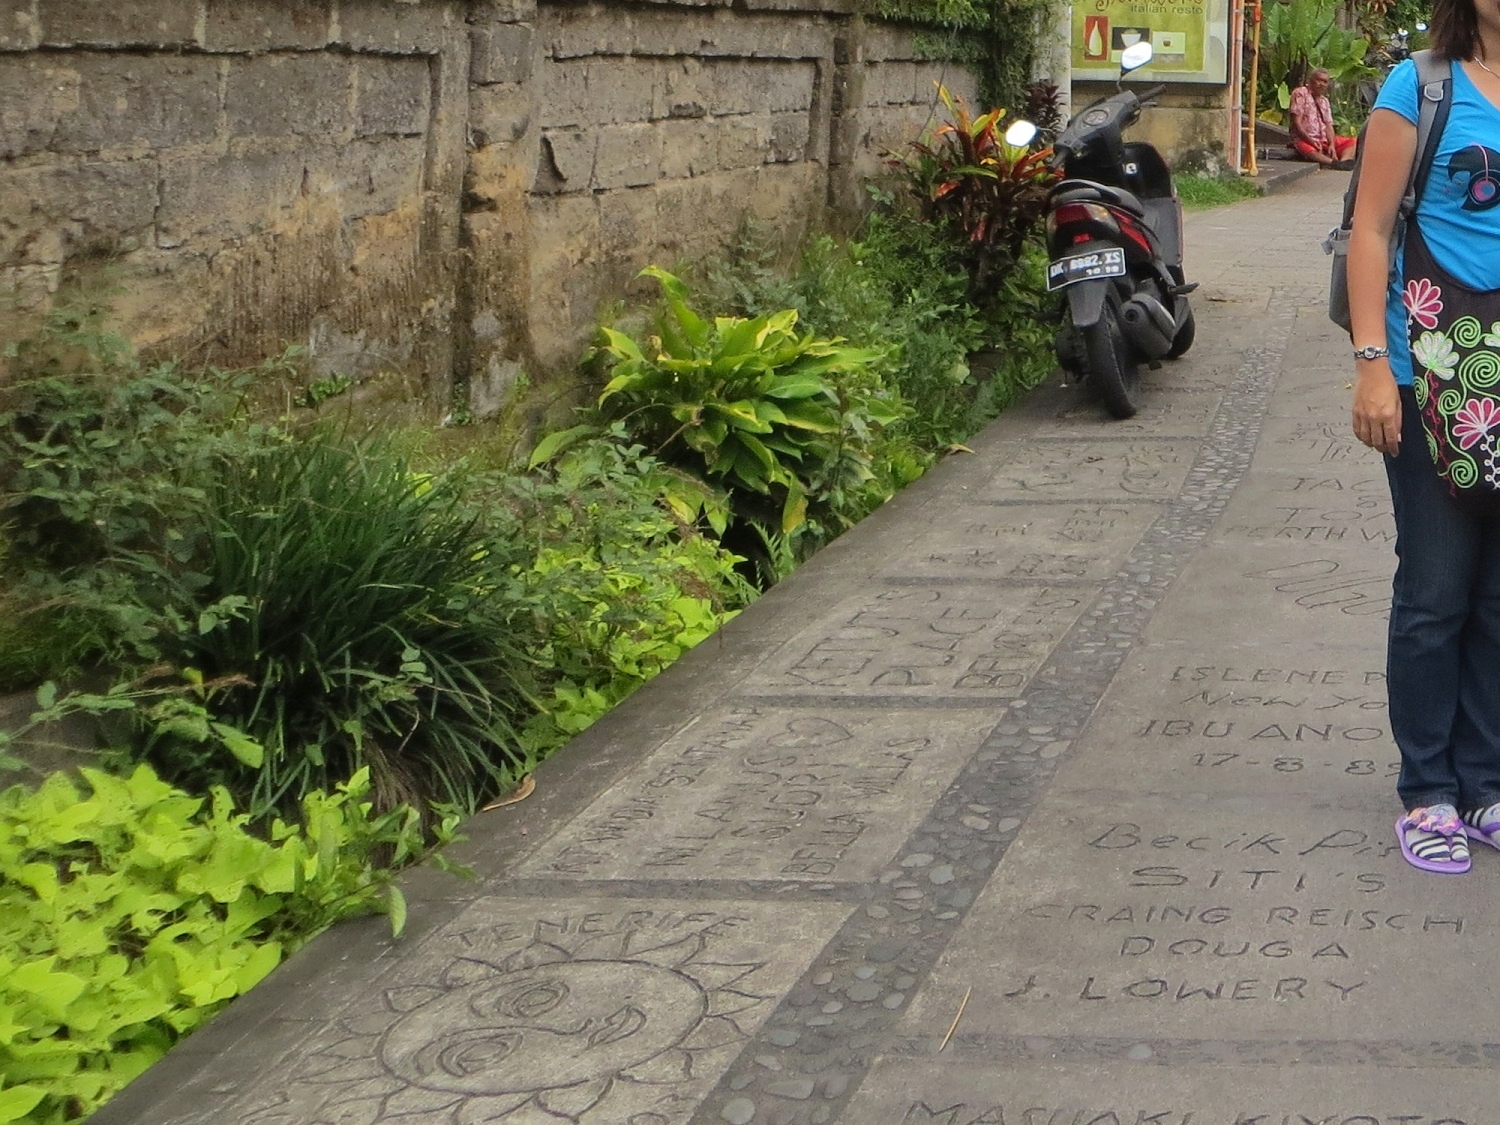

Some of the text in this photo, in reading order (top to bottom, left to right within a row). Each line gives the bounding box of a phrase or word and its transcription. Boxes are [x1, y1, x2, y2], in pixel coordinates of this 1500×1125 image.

[1131, 4, 1204, 15] italian resto
[1266, 906, 1465, 934] REISCH
[1079, 976, 1367, 1002] LOWERY
